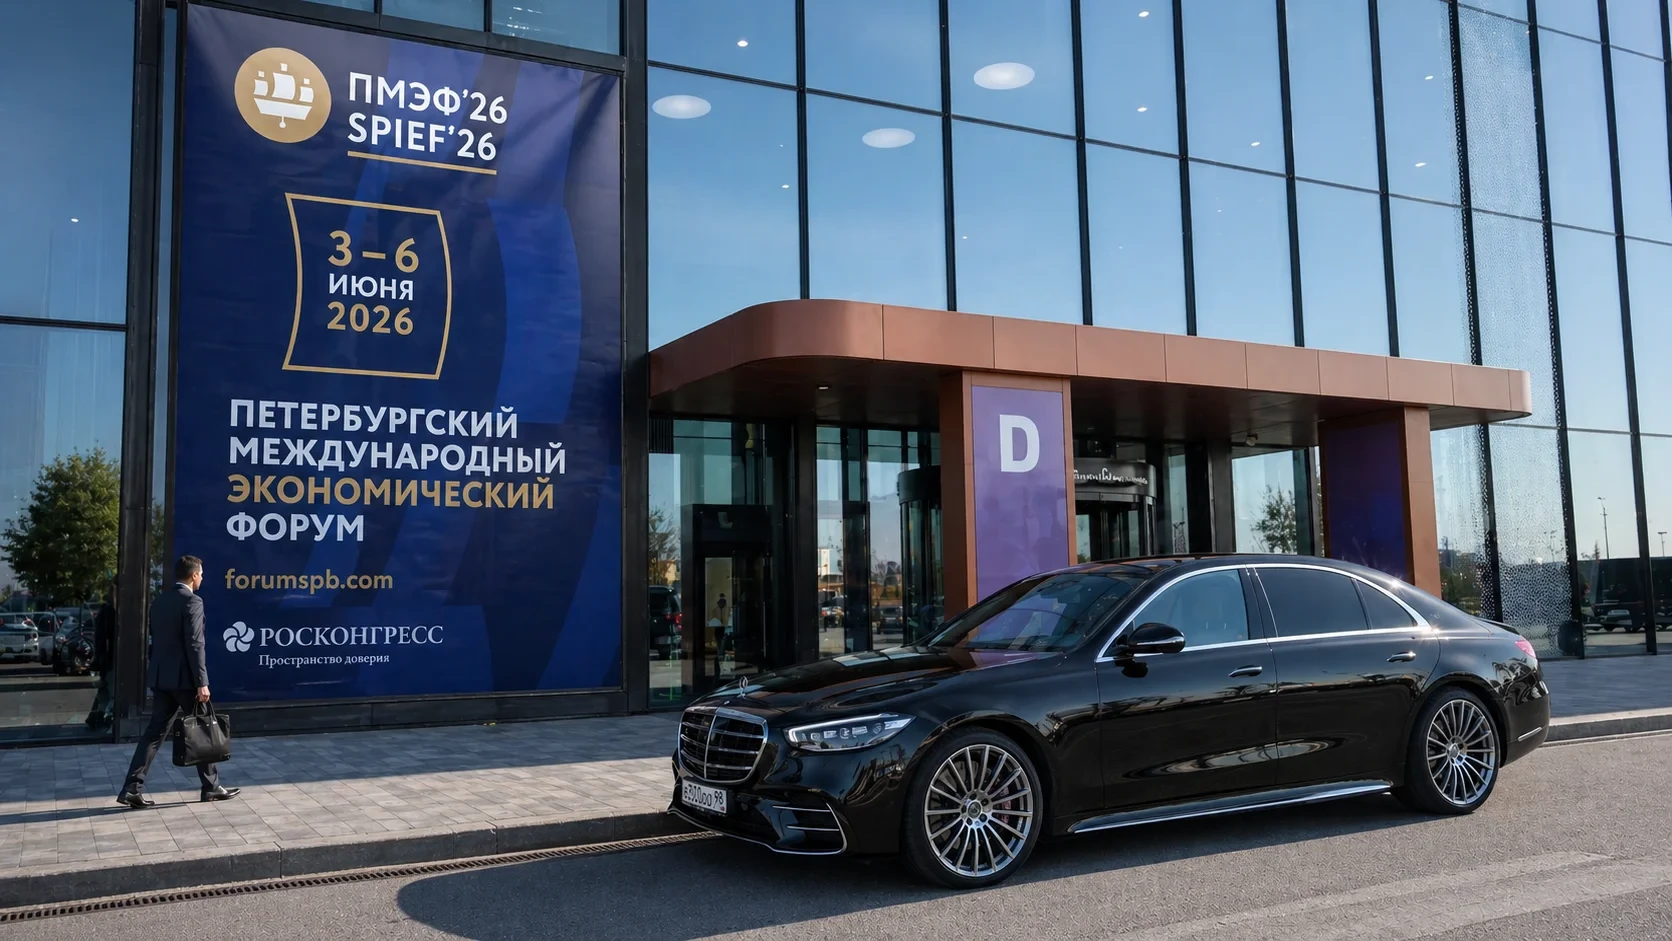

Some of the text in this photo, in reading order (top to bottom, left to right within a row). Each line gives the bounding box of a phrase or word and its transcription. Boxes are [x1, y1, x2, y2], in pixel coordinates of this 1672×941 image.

[327, 230, 353, 267] 3
[395, 237, 420, 273] 6
[328, 272, 414, 301] ИЮНЯ
[327, 301, 414, 336] 2026
[229, 398, 518, 439] ПЕТЕРБУРГСКИЙ
[228, 436, 566, 476] МЕЖДУНАРОДНЫЙ
[999, 414, 1040, 473] D
[226, 473, 554, 509] ЭКОНОМИЧЕСКИЙ
[225, 512, 364, 542] ФОРУМ
[224, 568, 393, 595] forumspb.com
[259, 625, 444, 647] РОСКОНГРЕСС
[258, 652, 390, 669] Пространство доверия
